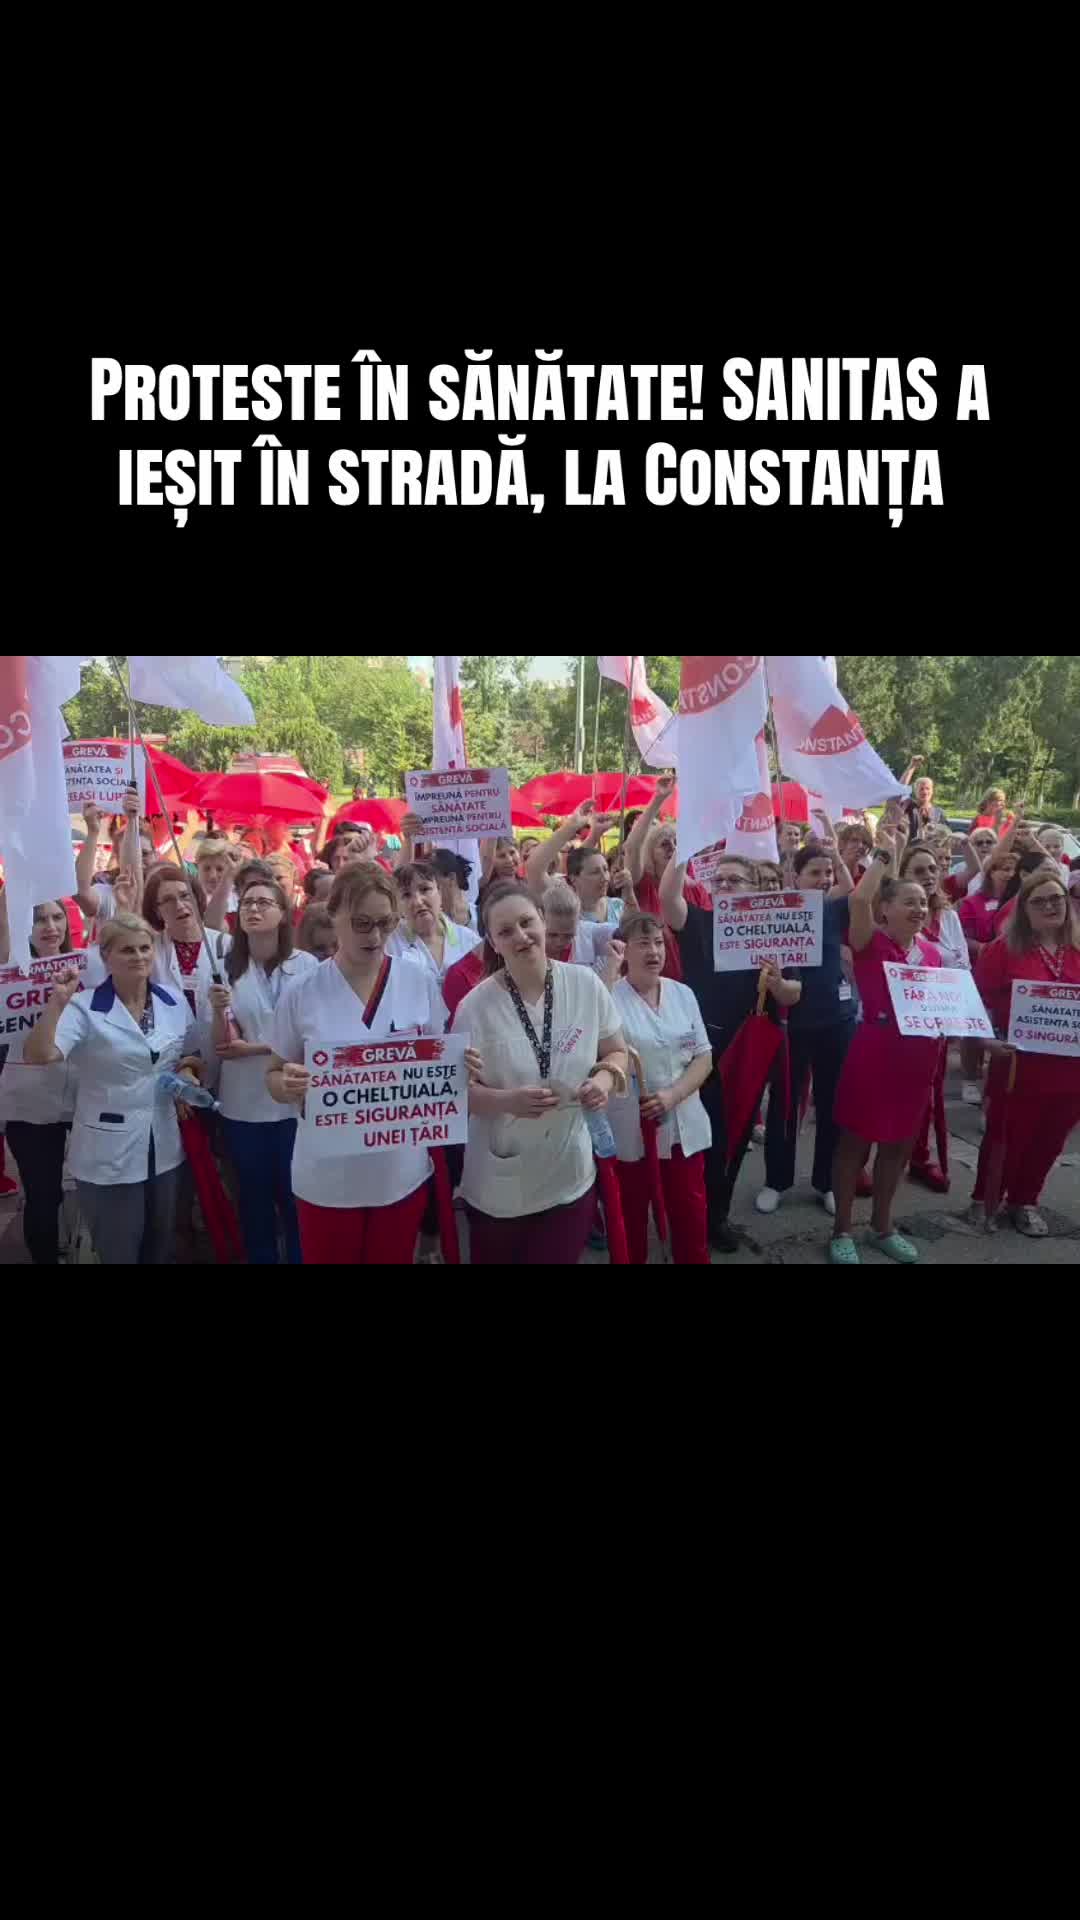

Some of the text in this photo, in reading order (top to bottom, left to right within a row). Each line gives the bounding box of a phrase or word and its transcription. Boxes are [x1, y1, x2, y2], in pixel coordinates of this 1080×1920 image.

[775, 912, 789, 921] NU
[724, 926, 734, 937] O
[720, 941, 739, 951] ESTE
[1049, 988, 1080, 1000] GREV
[1014, 1029, 1024, 1039] O
[362, 1041, 417, 1063] GREVĂ
[311, 1065, 456, 1087] SĂNĂTATEA NU ESTE
[322, 1091, 338, 1107] O
[315, 1101, 458, 1127] ESTE SIGURANȚA
[364, 1121, 448, 1147] UNEI ȚĂRI
